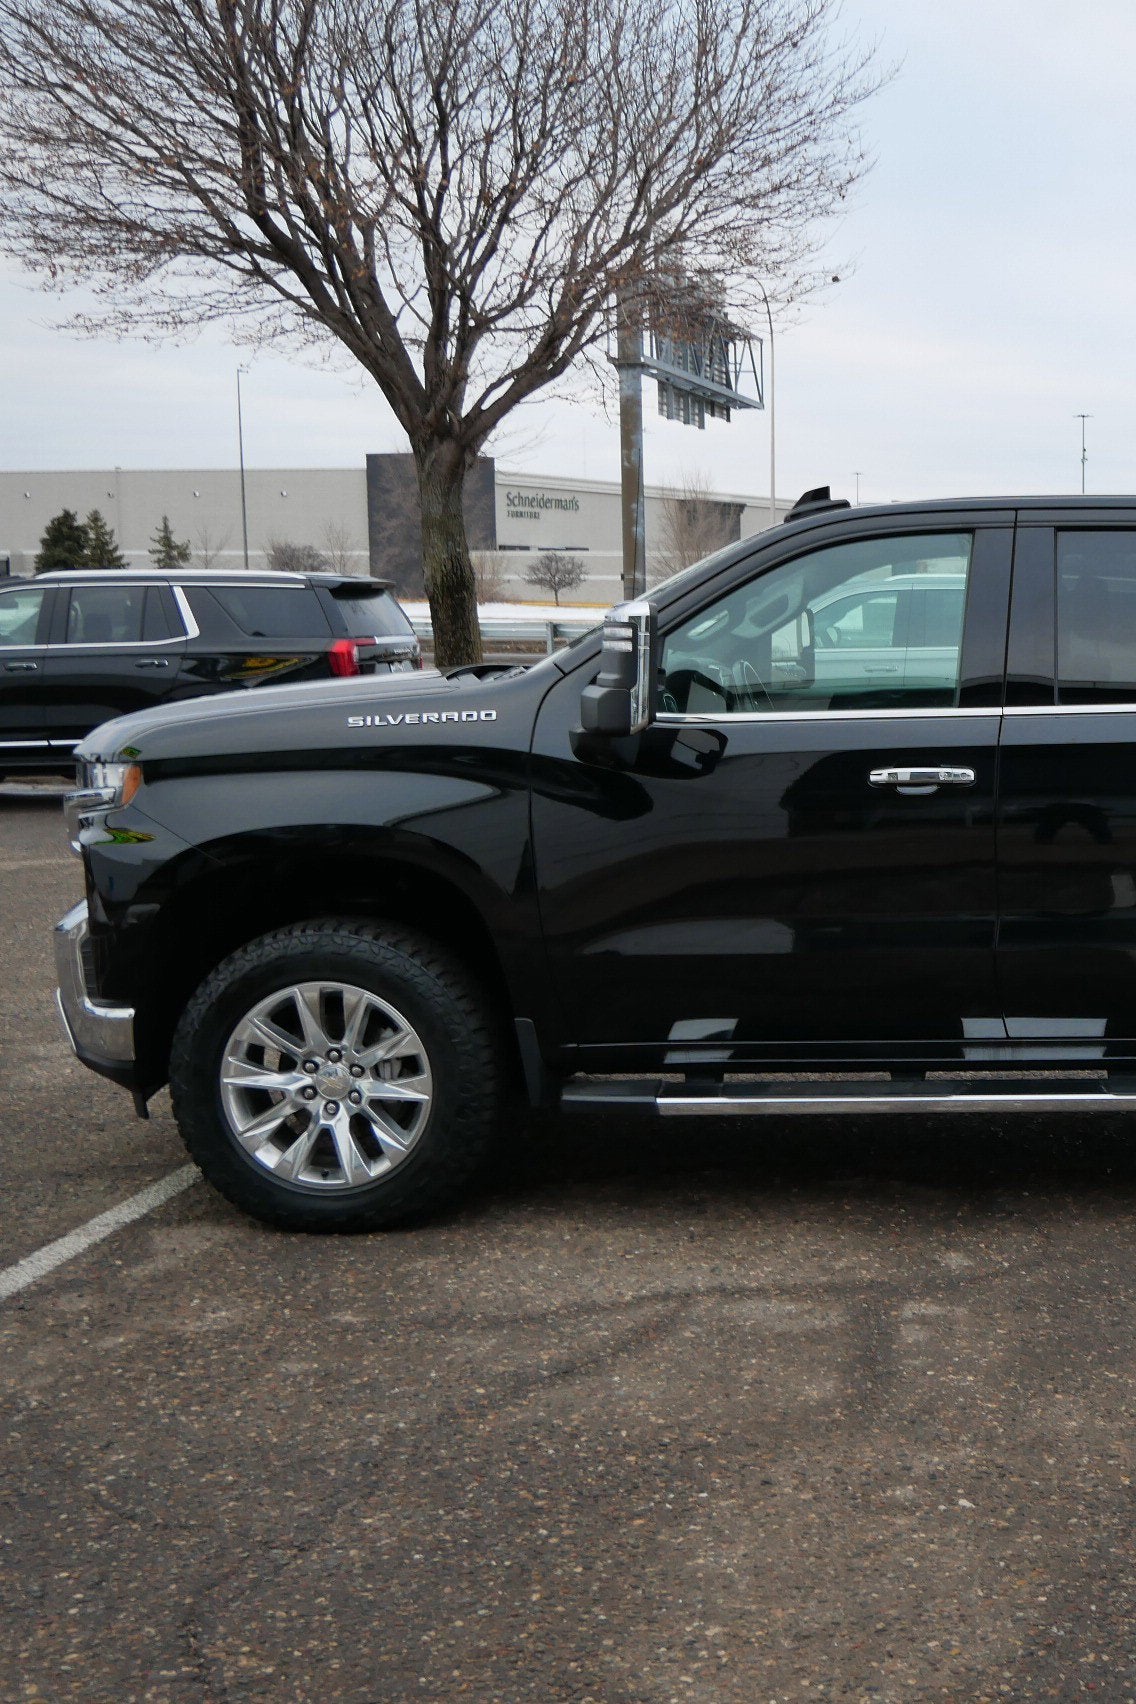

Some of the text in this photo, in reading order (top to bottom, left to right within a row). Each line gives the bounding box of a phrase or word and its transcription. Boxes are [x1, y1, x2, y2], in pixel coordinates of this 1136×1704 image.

[506, 491, 580, 512] Schneiderman's
[507, 510, 540, 519] FURNITURE
[347, 709, 498, 728] SILVERADO
